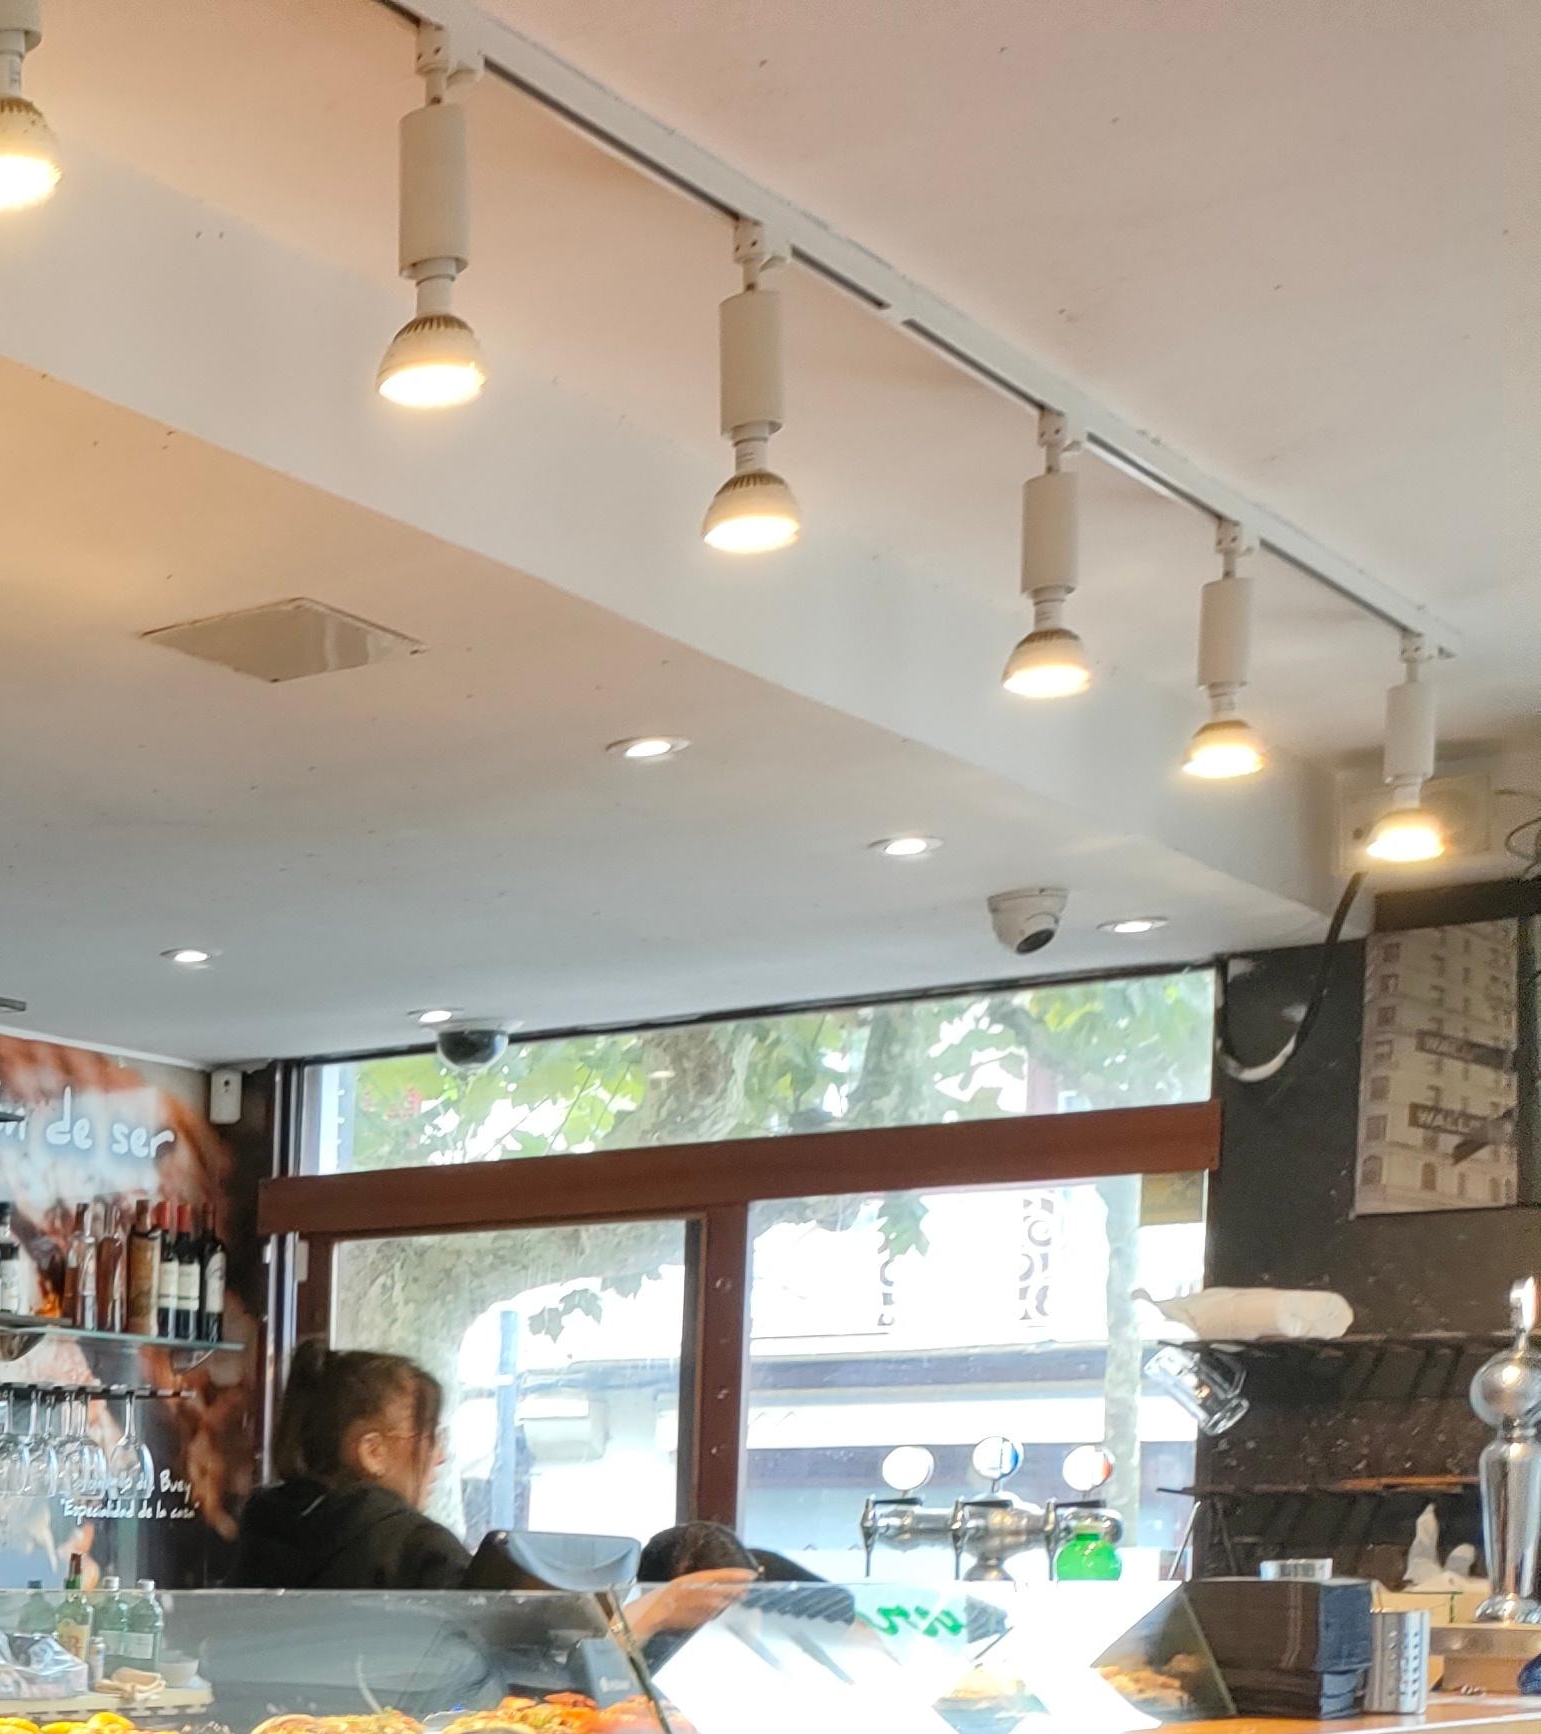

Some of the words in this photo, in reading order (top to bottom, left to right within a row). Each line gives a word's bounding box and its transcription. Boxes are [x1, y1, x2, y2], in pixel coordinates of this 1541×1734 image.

[46, 1086, 93, 1149] de
[112, 1123, 175, 1159] ser
[160, 1469, 191, 1501] Buey
[138, 1500, 153, 1518] de
[156, 1501, 166, 1518] la
